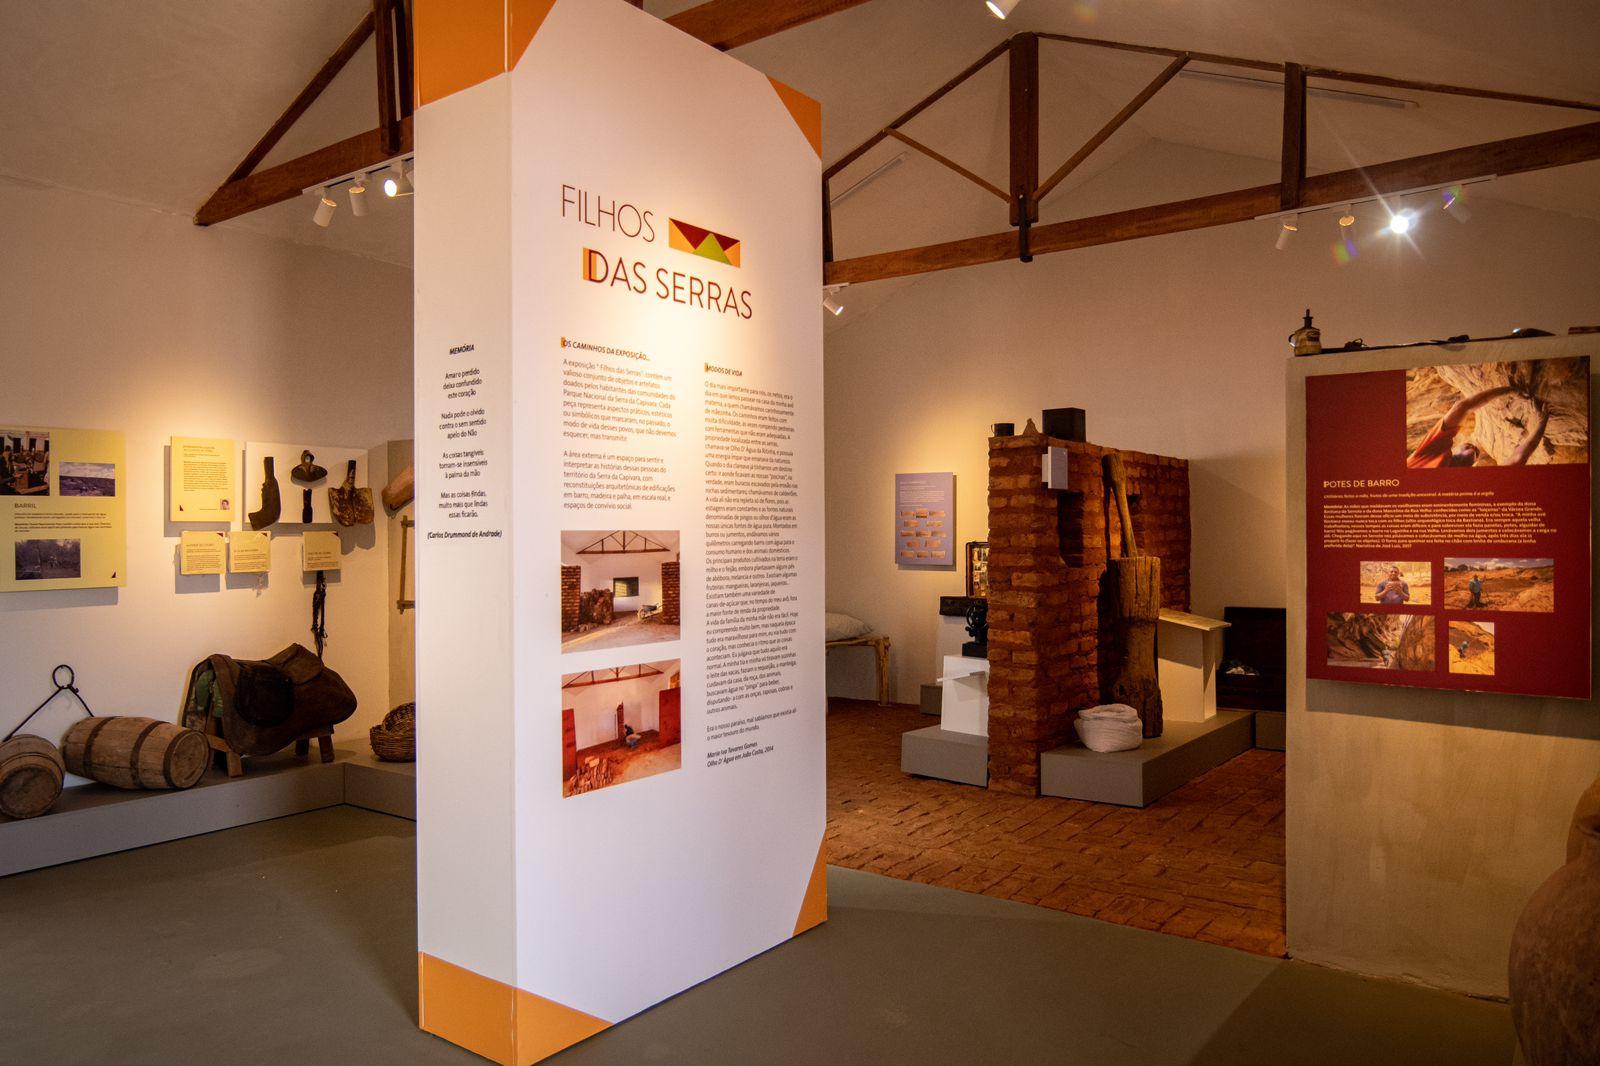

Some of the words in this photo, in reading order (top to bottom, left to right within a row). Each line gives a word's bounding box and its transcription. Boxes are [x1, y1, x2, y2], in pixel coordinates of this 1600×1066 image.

[562, 184, 655, 243] FILHOS
[588, 249, 647, 294] DAS
[656, 267, 753, 320] SERRAS
[449, 344, 475, 355] MEMÓRIA
[572, 341, 606, 354] CAMINHOS
[606, 348, 615, 356] DA
[731, 369, 743, 377] VIDA
[454, 411, 466, 419] pode
[1324, 480, 1351, 488] POTES
[1353, 480, 1365, 488] DE
[1367, 479, 1400, 487] BARRO
